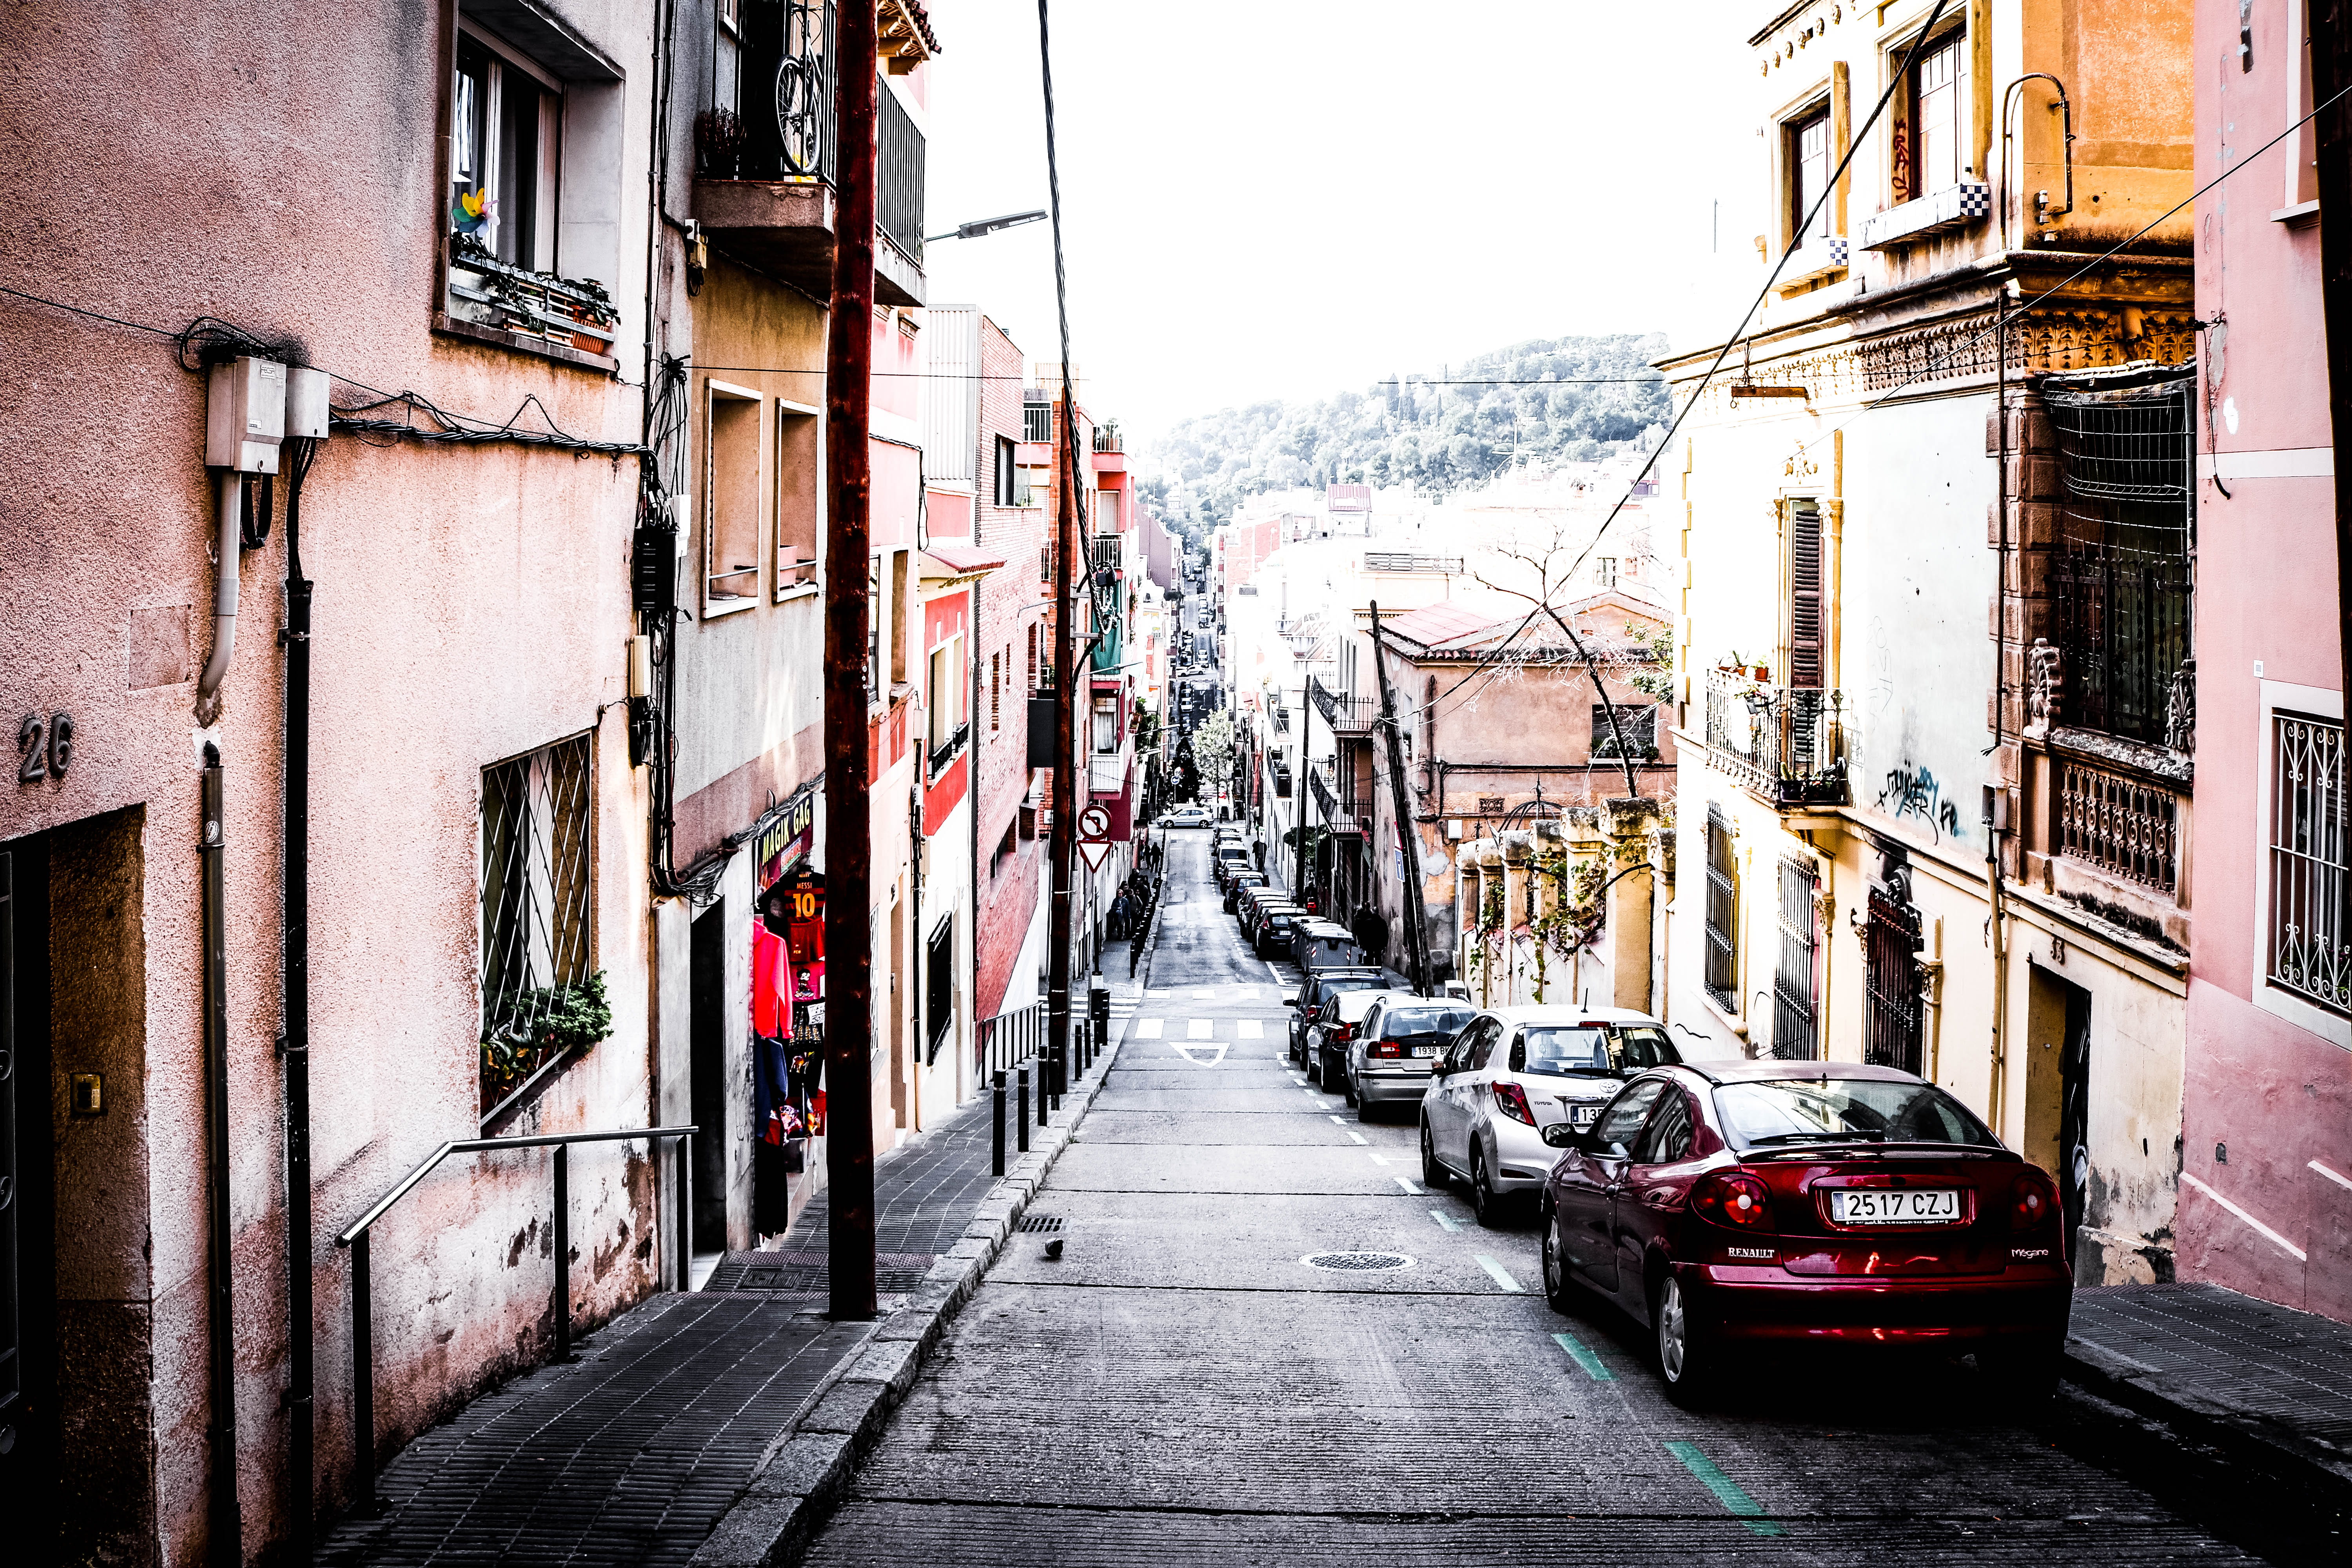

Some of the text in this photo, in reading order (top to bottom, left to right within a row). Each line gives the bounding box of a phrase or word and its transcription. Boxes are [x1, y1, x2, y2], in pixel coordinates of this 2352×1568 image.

[20, 715, 72, 779] 26
[762, 815, 789, 866] MAGIK
[793, 799, 810, 835] GAG
[793, 893, 815, 917] 10
[1849, 1194, 1904, 1216] 2517
[1913, 1194, 1953, 1215] CZJ
[1728, 1247, 1775, 1258] RENAULT
[2012, 1249, 2049, 1258] Mégane
